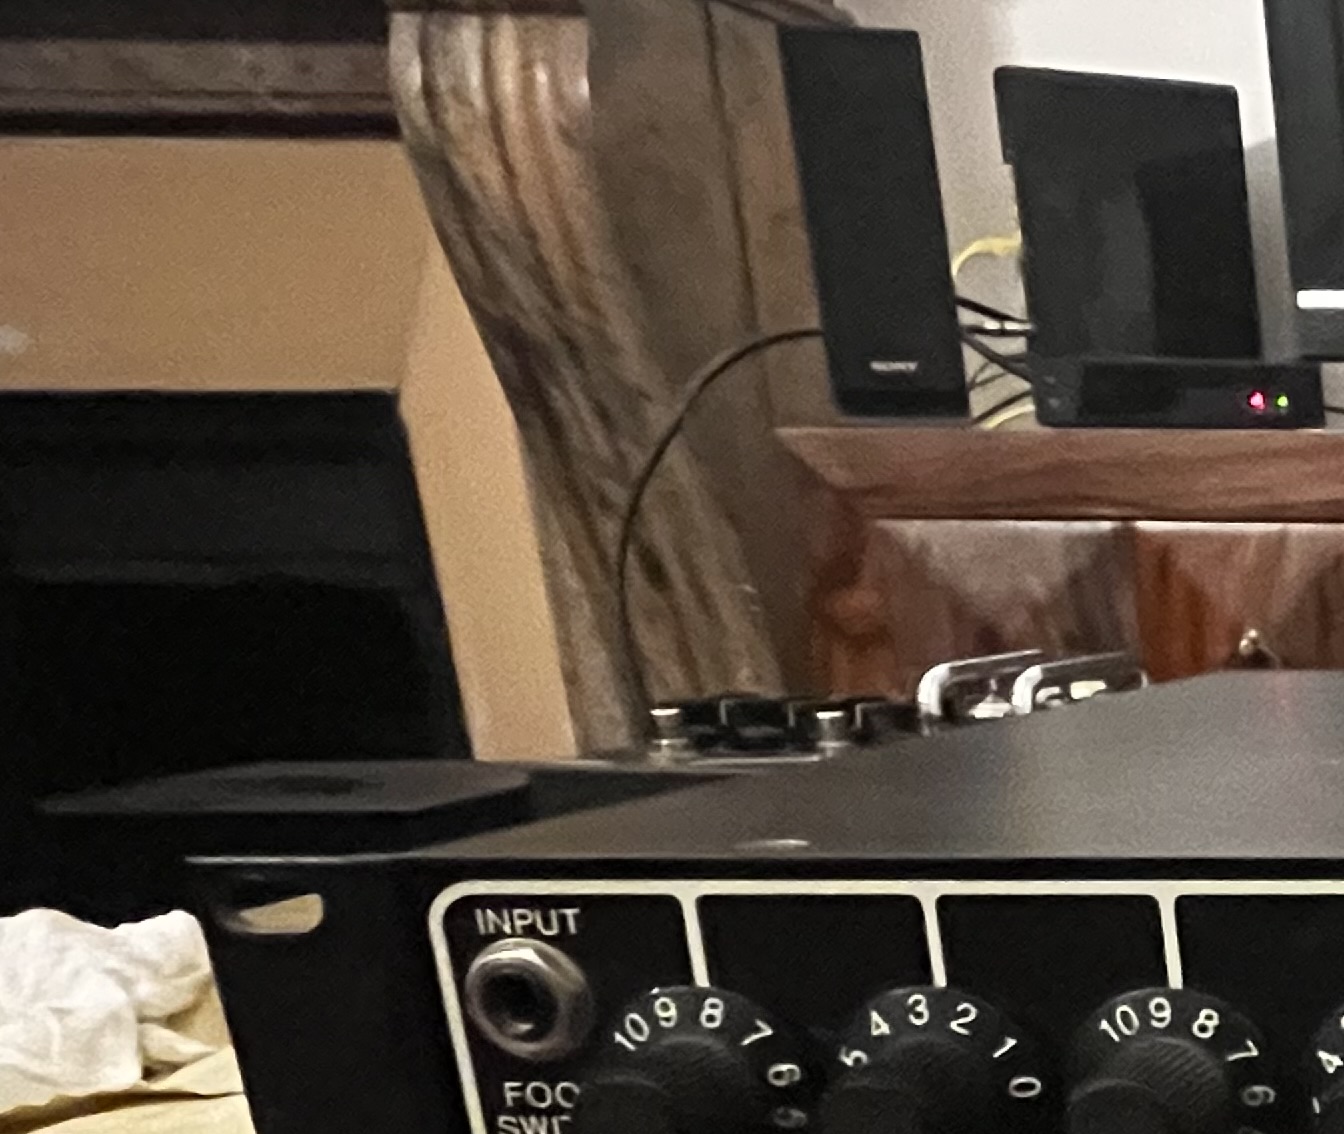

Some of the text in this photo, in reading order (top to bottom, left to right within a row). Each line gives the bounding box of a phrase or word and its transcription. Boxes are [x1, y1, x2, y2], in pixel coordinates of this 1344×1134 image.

[475, 907, 580, 935] INPUT
[613, 1012, 650, 1051] 10
[654, 996, 678, 1028] 9
[700, 997, 724, 1029] 8
[740, 1018, 773, 1046] 7
[1100, 1004, 1140, 1042] 10
[1148, 996, 1172, 1028] 9
[1191, 1008, 1220, 1039] 8
[1224, 1038, 1260, 1061] 7
[838, 1046, 870, 1068] 5
[870, 1009, 892, 1036] 4
[907, 993, 930, 1026] 3
[950, 1002, 979, 1036] 2
[991, 1036, 1018, 1059] 1
[1008, 1076, 1042, 1098] 0
[1316, 1049, 1344, 1074] 4
[502, 1081, 581, 1109] FOO
